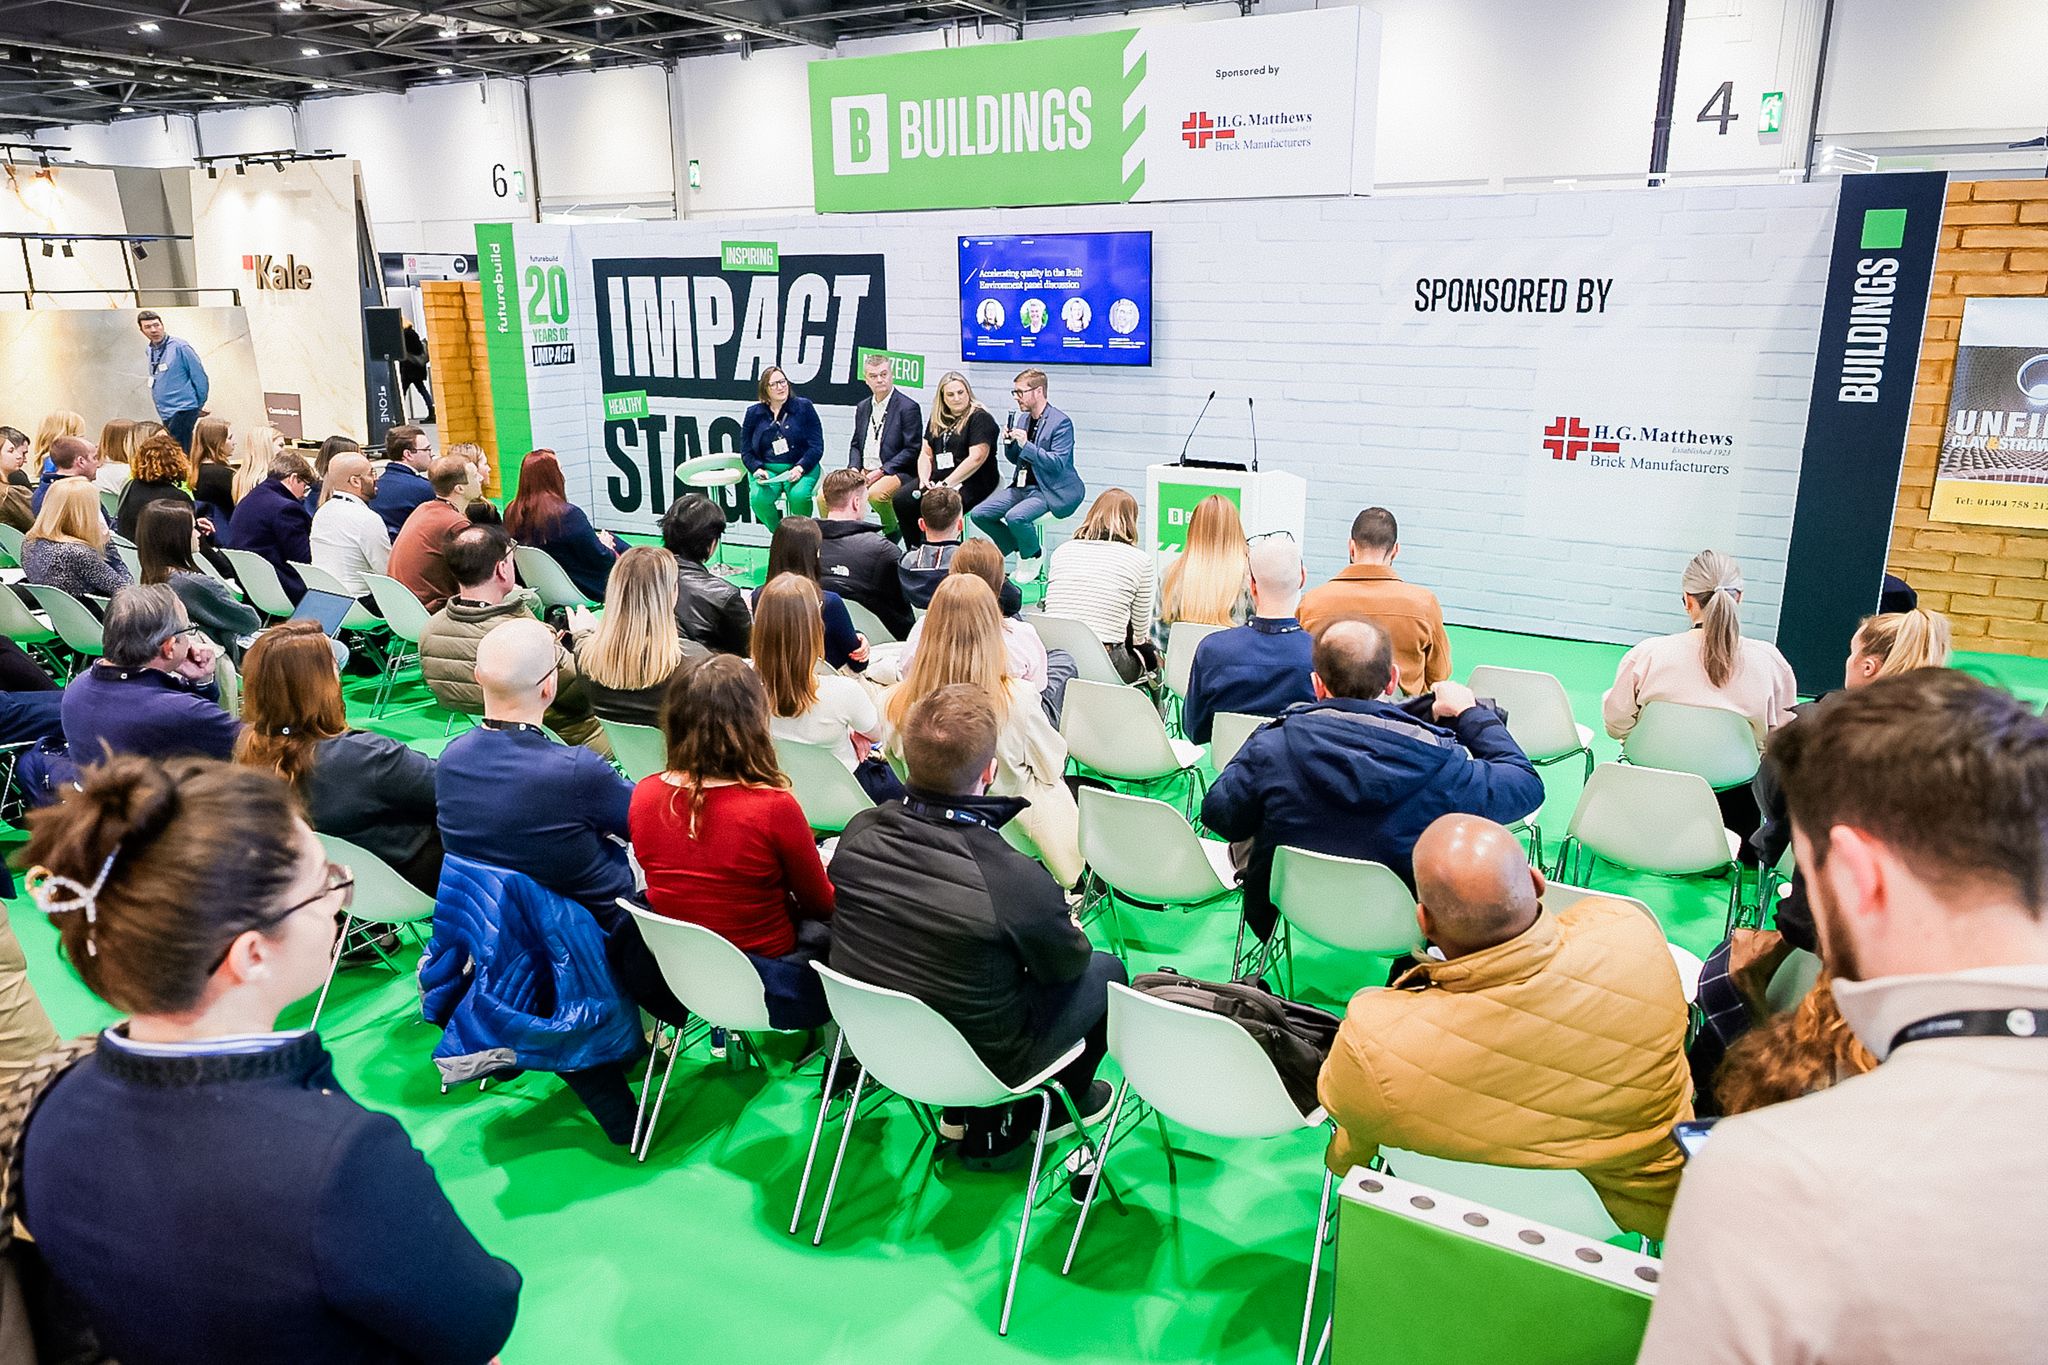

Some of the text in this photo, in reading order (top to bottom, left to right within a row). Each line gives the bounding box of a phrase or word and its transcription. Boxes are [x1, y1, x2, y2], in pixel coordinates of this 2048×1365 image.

[1215, 65, 1280, 80] Sponsored by
[850, 86, 1092, 163] B BUILDINGS
[1697, 81, 1739, 135] 4
[1215, 138, 1312, 152] Brick Manufacturers
[492, 163, 508, 198] 6
[254, 254, 312, 290] Kale
[725, 246, 774, 266] INSPIRING
[489, 243, 509, 334] futurebuild
[524, 264, 570, 325] 20
[1415, 278, 1613, 313] SPONSORED BY
[532, 327, 569, 343] YEARS OF
[606, 272, 871, 384] IMPACT
[1838, 257, 1900, 403] BUILDINGS
[534, 345, 574, 366] IMPACT
[889, 357, 919, 382] ZERO
[607, 396, 642, 415] HEALTHY
[1954, 409, 2048, 440] UNFI
[603, 413, 784, 524] STAG
[1590, 454, 1730, 475] Brick Manufacturers
[1955, 497, 1973, 506] Tel:
